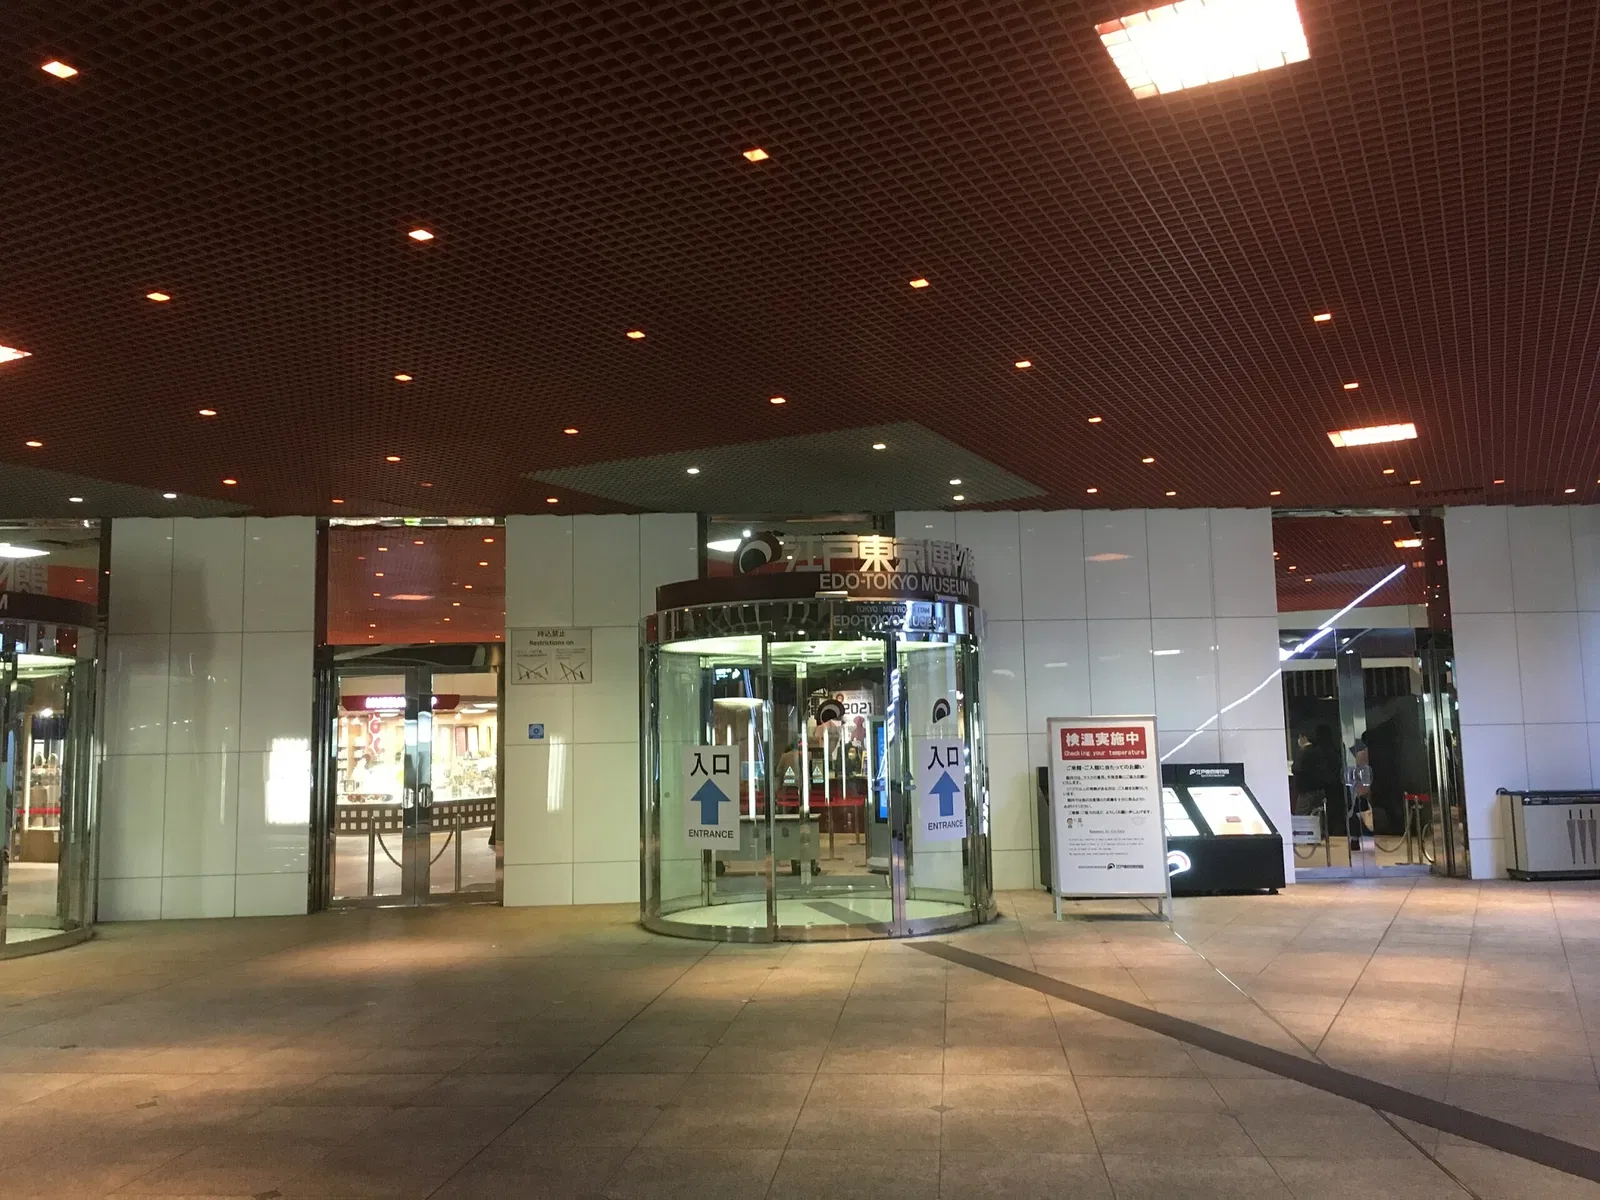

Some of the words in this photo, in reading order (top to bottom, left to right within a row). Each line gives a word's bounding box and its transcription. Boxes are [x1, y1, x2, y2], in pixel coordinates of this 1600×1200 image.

[819, 573, 918, 590] EDO-TOKYO
[921, 575, 969, 596] MUSEUM
[856, 605, 878, 613] TOKYO
[843, 702, 872, 715] 2021
[1065, 731, 1140, 747] 検温実施中
[927, 746, 959, 770] 入口
[1109, 749, 1145, 757] temperature
[690, 752, 730, 776] 入口
[928, 819, 963, 831] ENTRANCE
[688, 829, 734, 839] ENTRANCE
